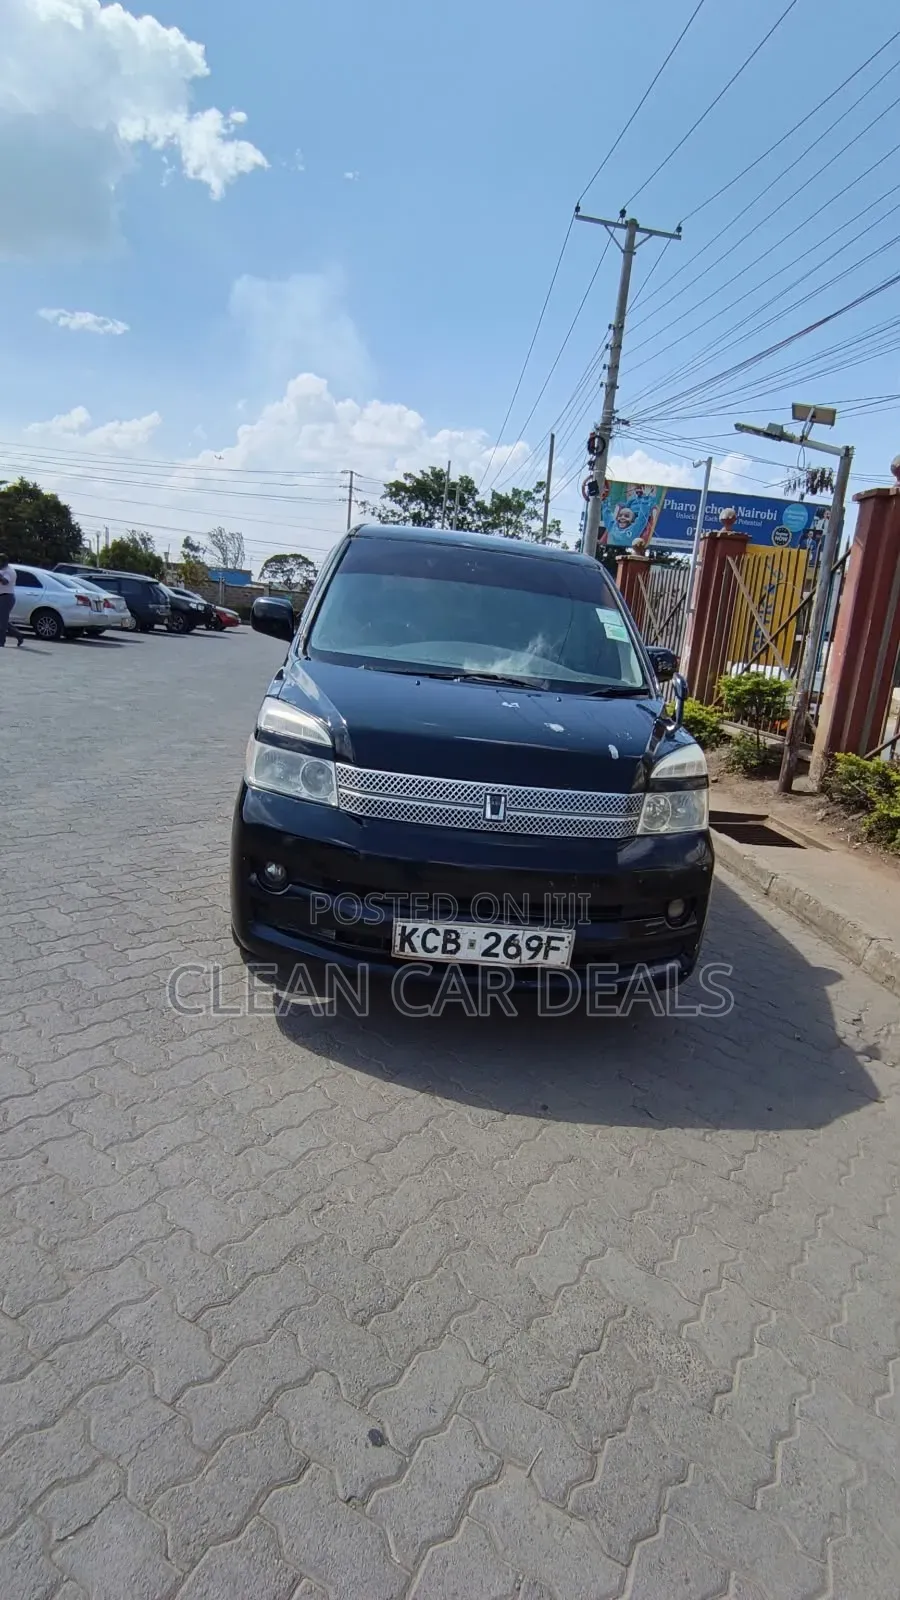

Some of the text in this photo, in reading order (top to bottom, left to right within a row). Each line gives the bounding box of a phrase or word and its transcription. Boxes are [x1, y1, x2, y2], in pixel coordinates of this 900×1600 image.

[663, 499, 697, 512] Pharo
[704, 503, 735, 515] cho
[737, 506, 778, 521] Nairobi
[399, 924, 566, 961] KCB 269F
